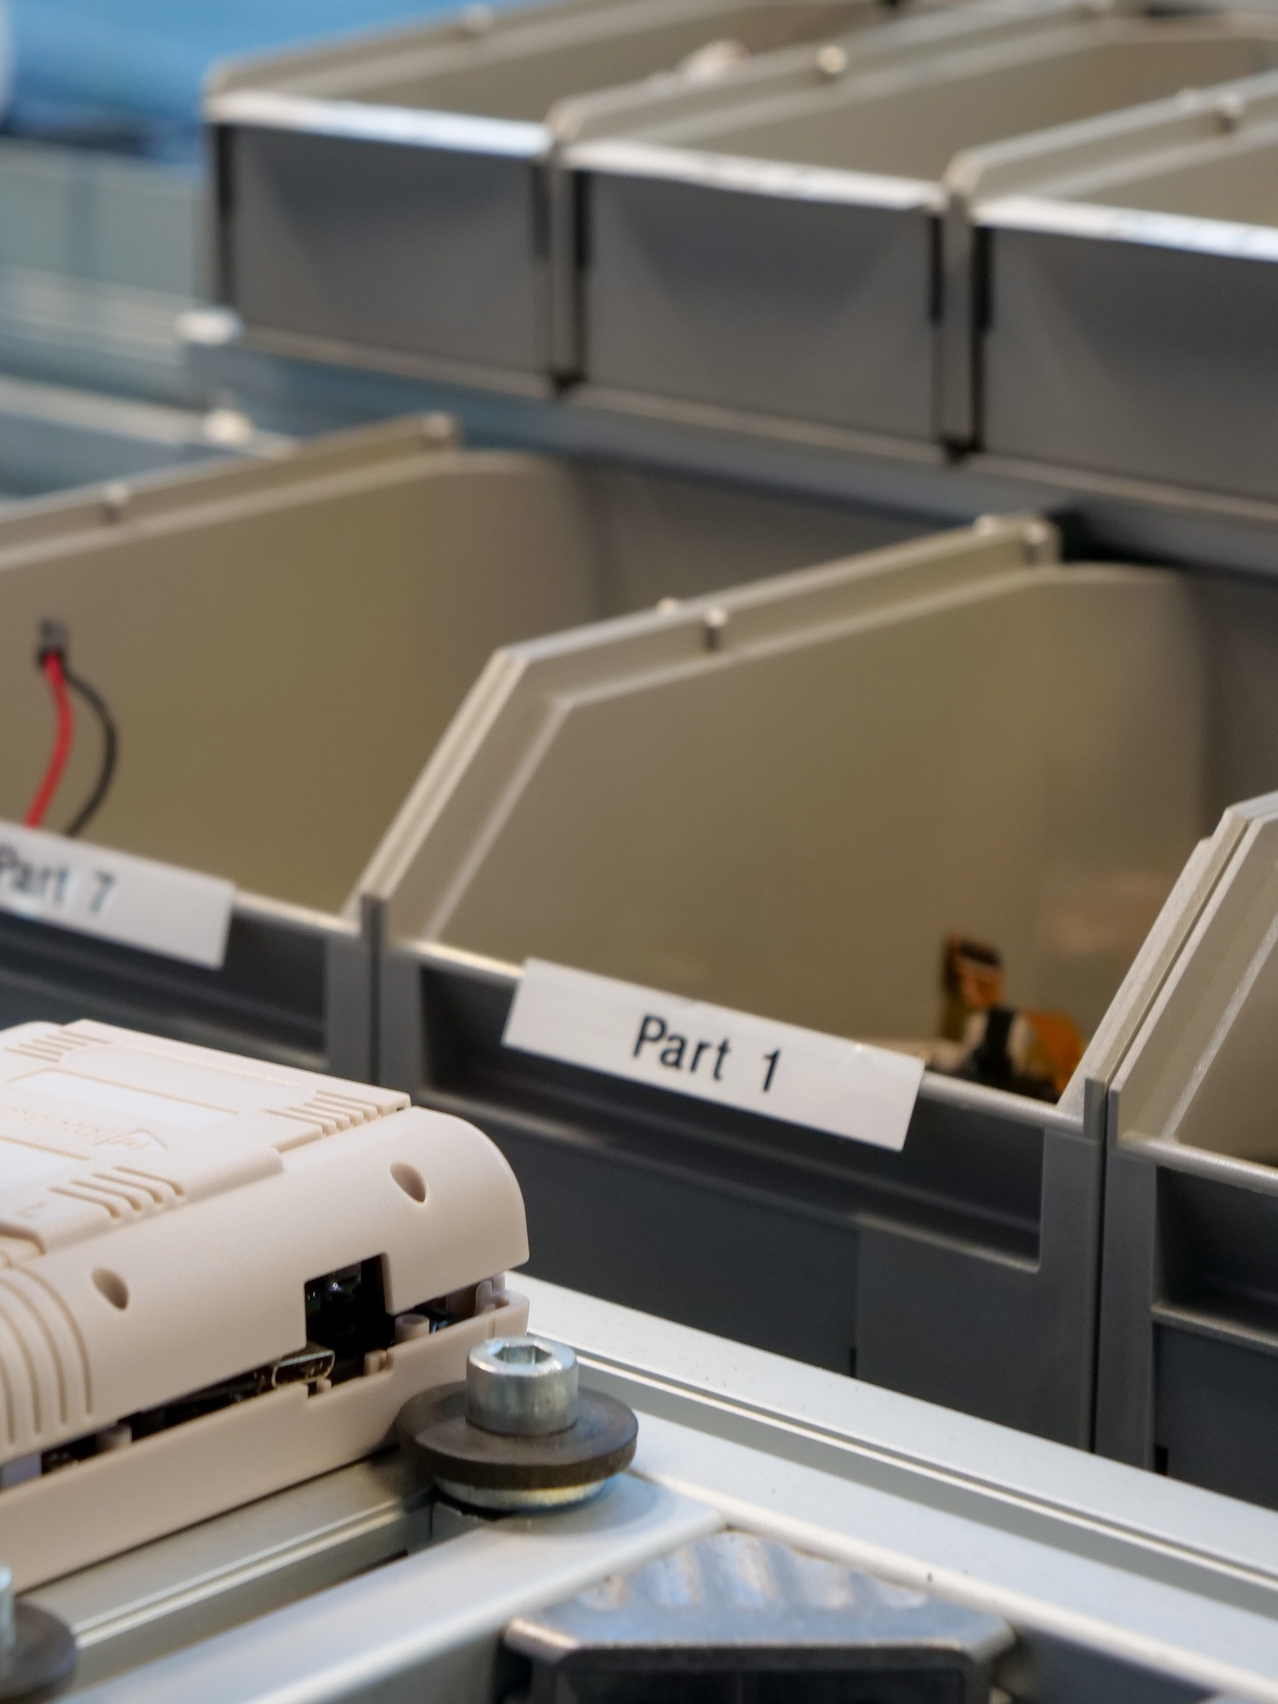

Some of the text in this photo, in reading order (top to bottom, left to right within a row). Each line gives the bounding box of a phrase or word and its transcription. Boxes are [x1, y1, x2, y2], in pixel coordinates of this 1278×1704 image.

[89, 871, 117, 914] 7
[632, 1013, 783, 1093] Part 1
